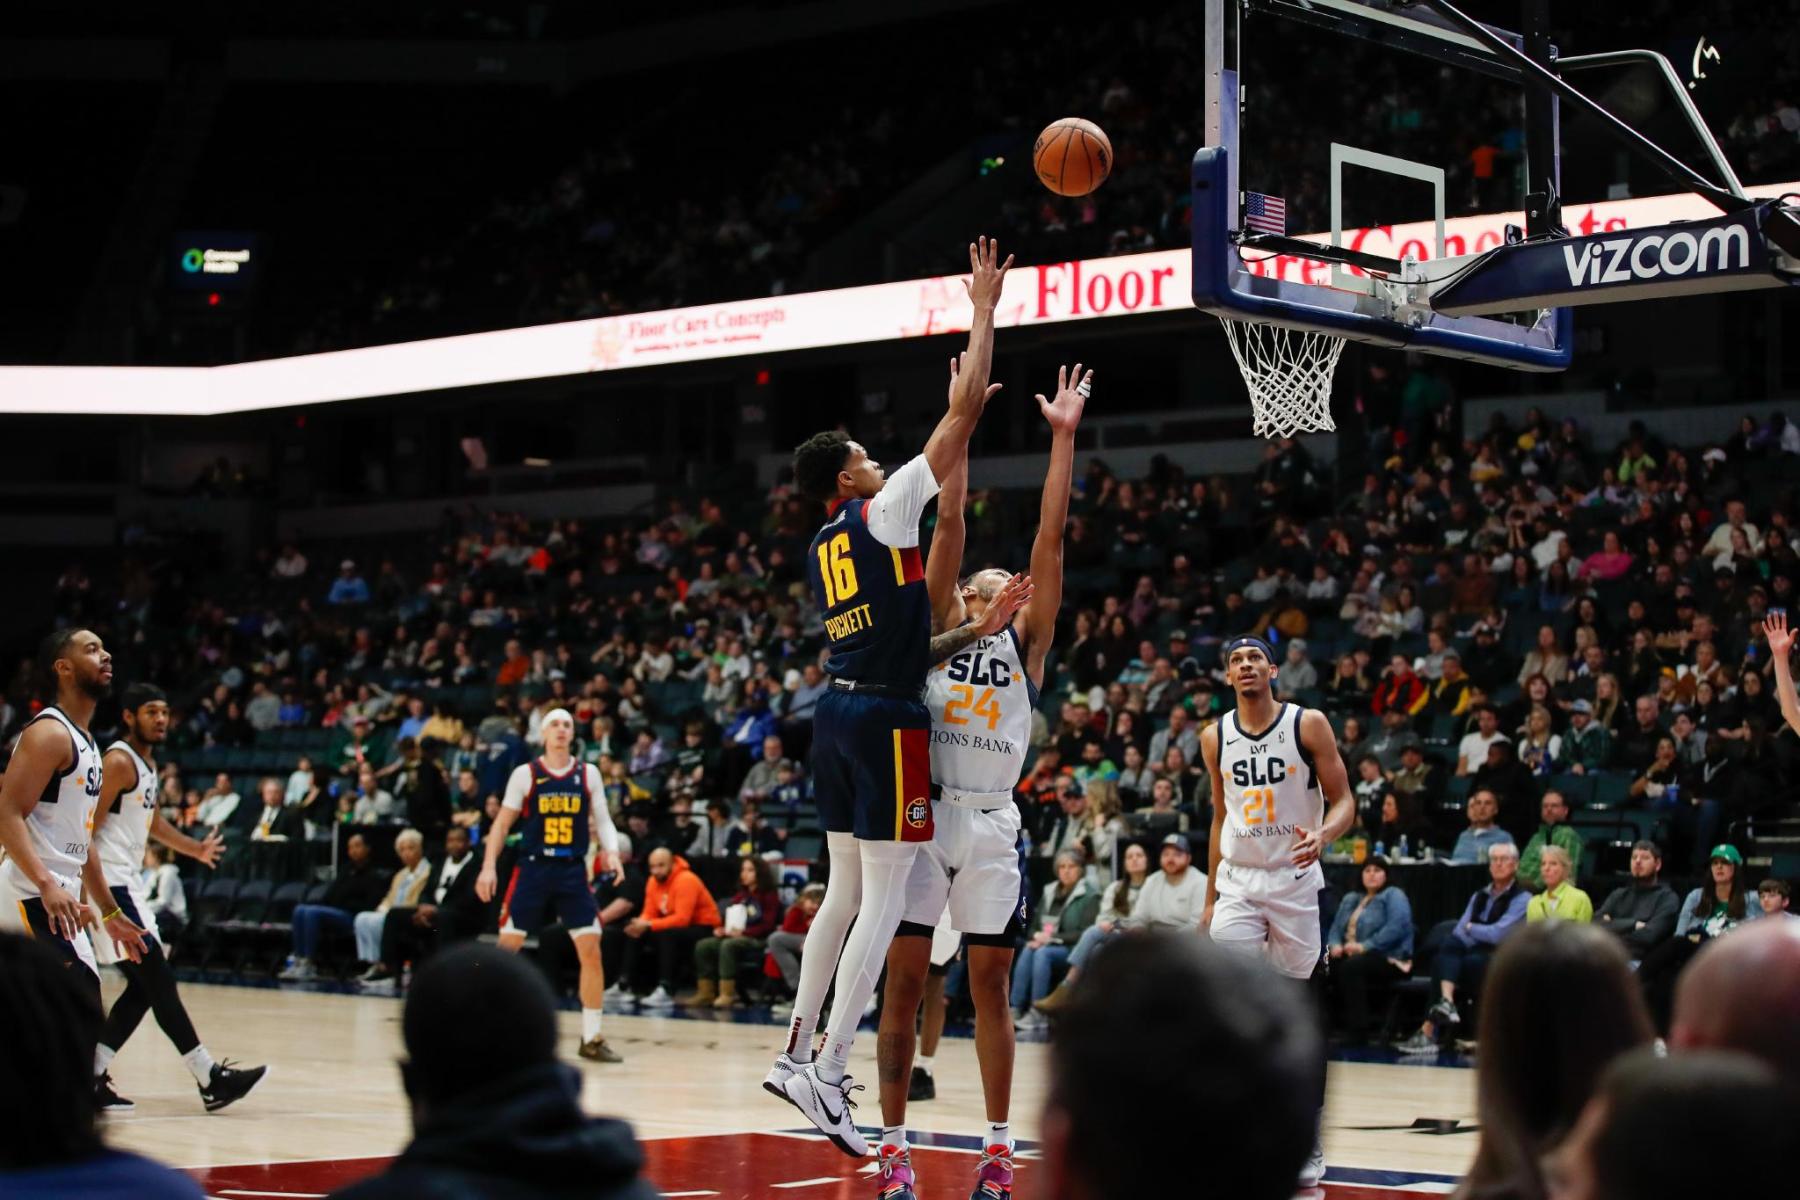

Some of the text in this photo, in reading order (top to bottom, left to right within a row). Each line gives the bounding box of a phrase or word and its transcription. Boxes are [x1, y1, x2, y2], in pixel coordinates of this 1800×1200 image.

[1034, 260, 1174, 319] Floor
[672, 314, 709, 334] Care
[714, 306, 786, 330] Concepts
[817, 532, 859, 608] 16
[825, 603, 873, 643] PICKETT
[947, 653, 1011, 687] SLC
[943, 684, 1002, 731] 24
[973, 735, 1014, 755] BANK
[1232, 757, 1286, 787] SLC
[1242, 787, 1276, 826] 21
[544, 817, 573, 844] 55
